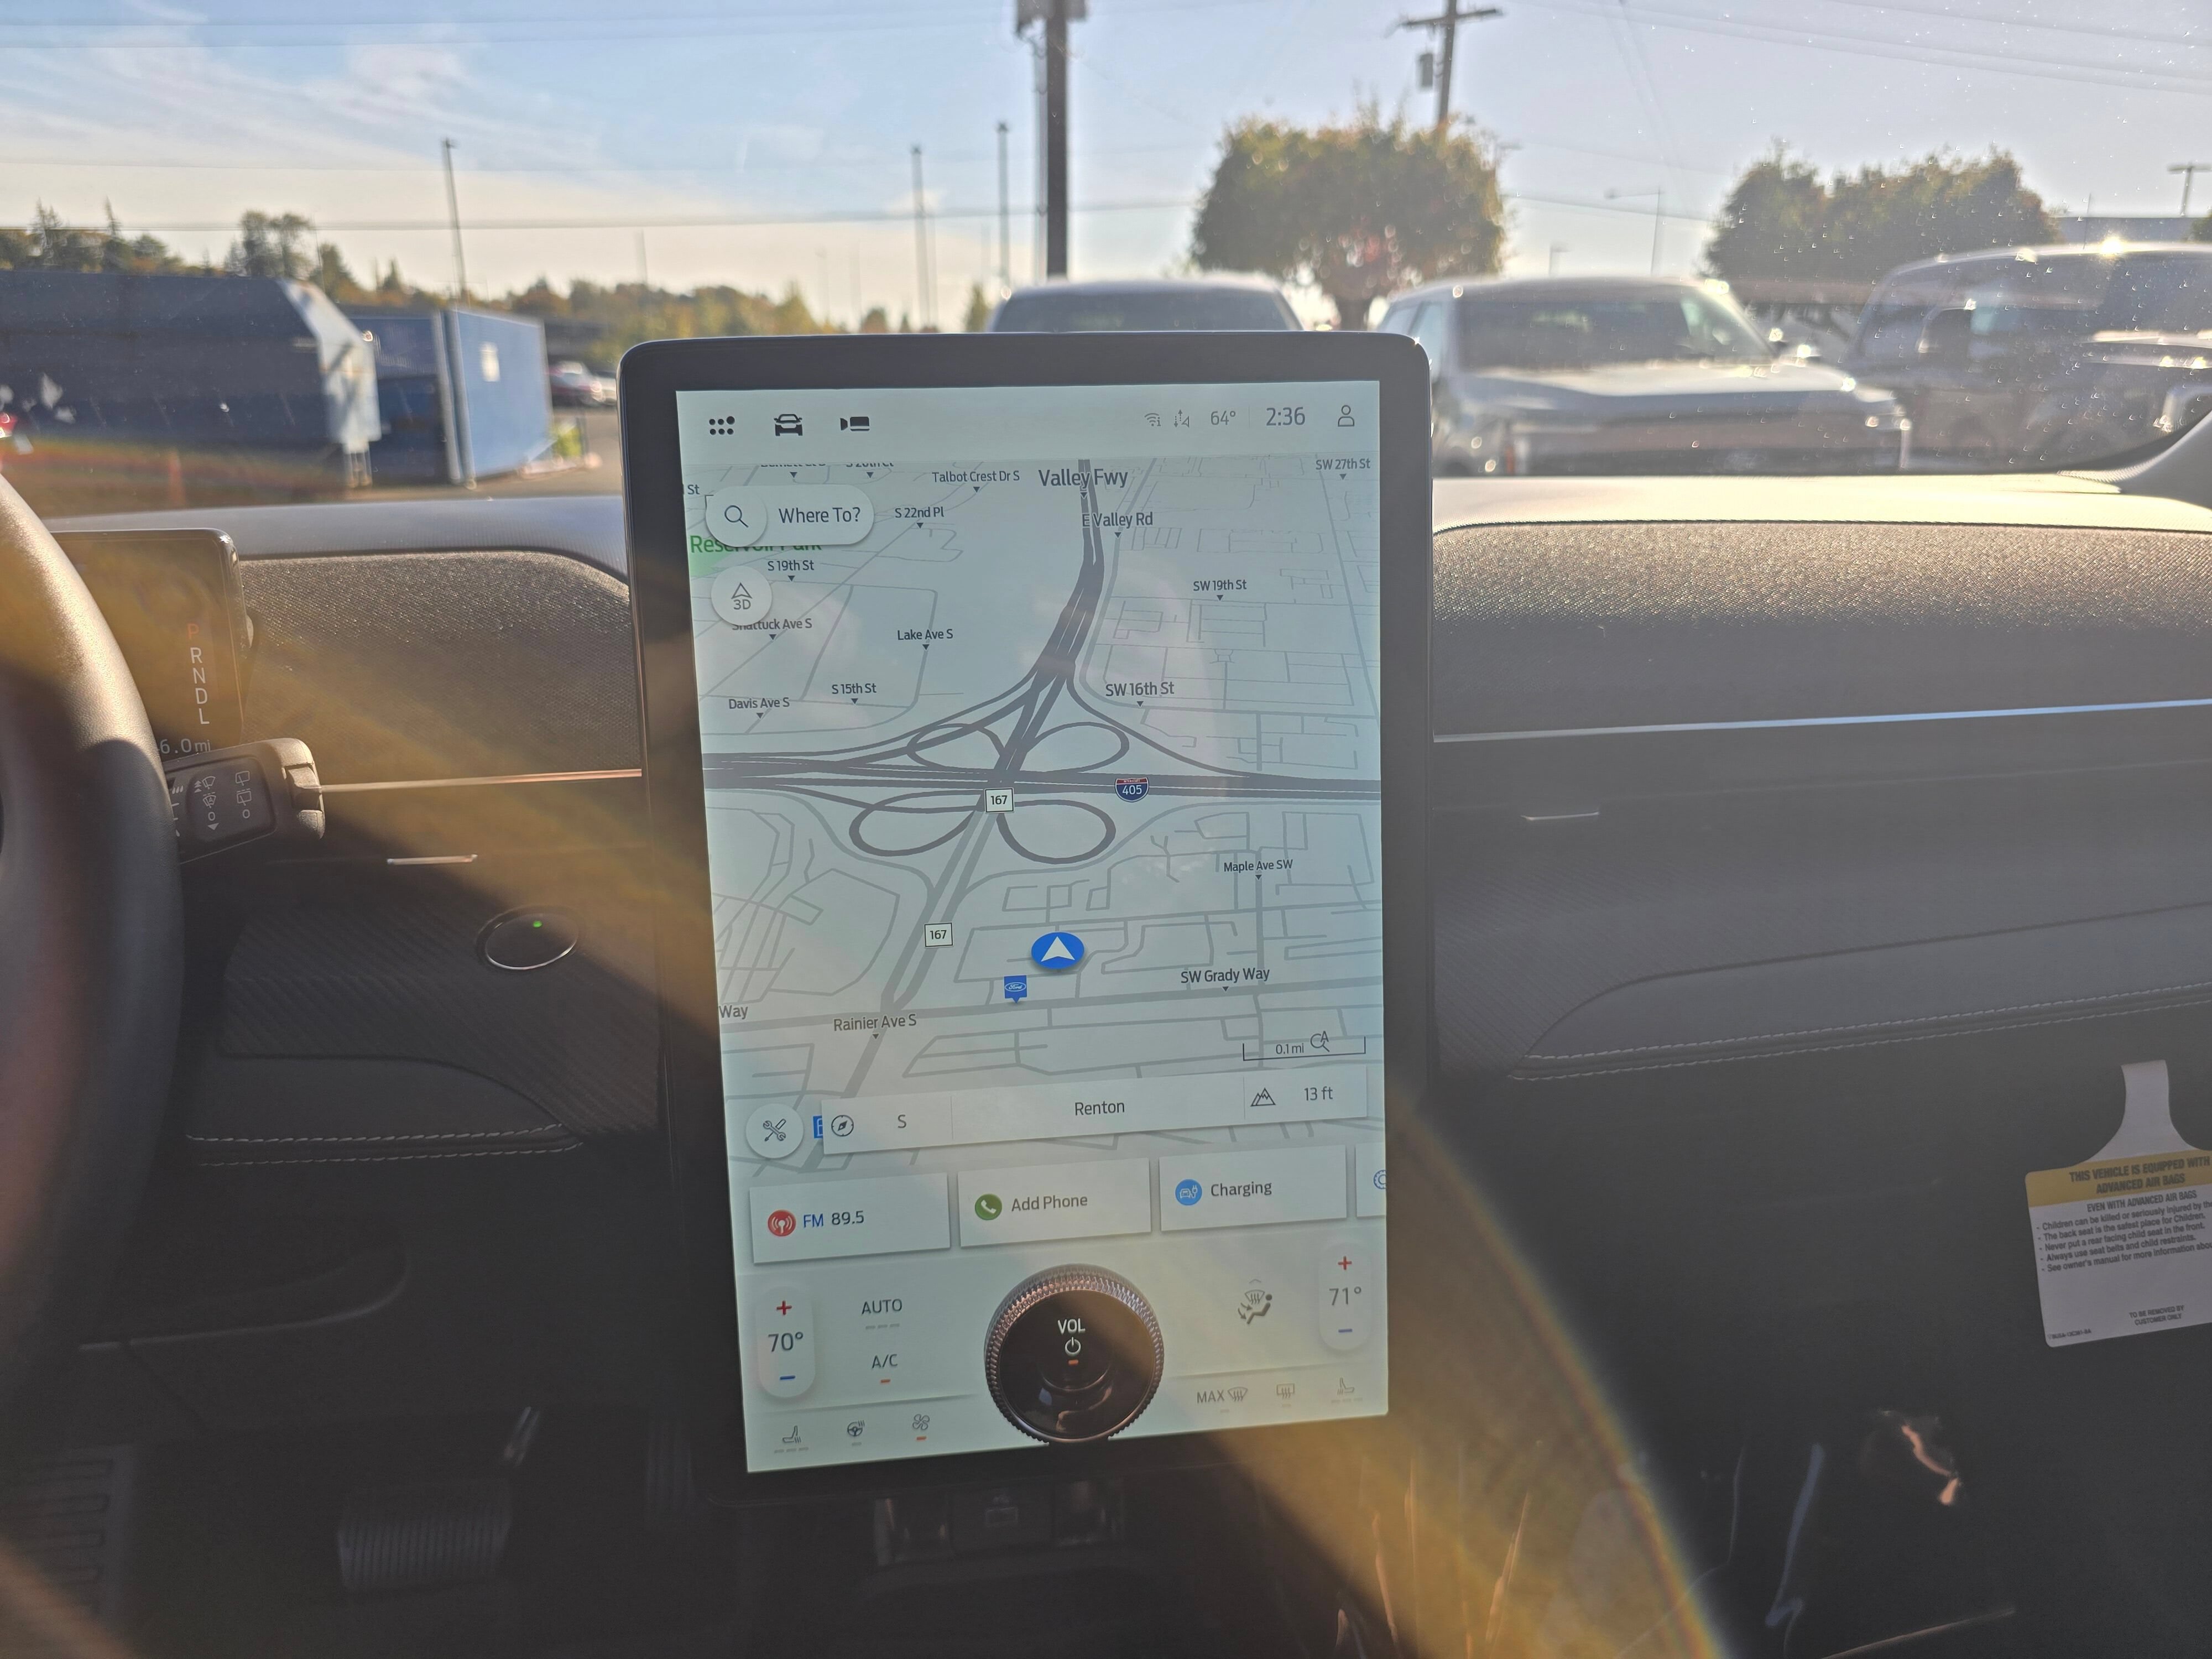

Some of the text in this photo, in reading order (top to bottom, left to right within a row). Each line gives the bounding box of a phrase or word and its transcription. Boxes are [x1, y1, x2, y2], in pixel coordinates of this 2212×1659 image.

[1211, 410, 1236, 426] 64°
[1266, 406, 1306, 426] 2:36
[1316, 458, 1370, 470] SW 27th St
[932, 471, 1020, 483] Talbot Crest Dr S
[1038, 468, 1128, 489] Valley Fwy
[687, 484, 700, 494] St
[779, 507, 861, 524] Where To?
[895, 506, 944, 519] S 22nd Pl
[1082, 512, 1153, 529] E Valley Rd
[768, 560, 814, 571] S 19th St
[1193, 580, 1247, 592] SW 19th St
[733, 599, 751, 611] 3D
[782, 619, 802, 629] Ave
[805, 618, 812, 628] S
[898, 629, 953, 641] Lake Ave S
[187, 623, 210, 724] P R N D L
[832, 683, 877, 695] S 15th St
[1106, 682, 1175, 697] SW 16th St
[729, 697, 790, 709] Davis Ave S
[1122, 785, 1142, 795] 405
[991, 795, 1008, 805] 167
[1224, 859, 1293, 874] Maple Ave SW
[930, 930, 947, 940] 167
[1181, 968, 1270, 984] SW Grady Way
[719, 1005, 748, 1020] Way
[833, 1014, 917, 1031] Rainier Ave S
[1304, 1086, 1333, 1100] 13 ft
[1074, 1101, 1125, 1115] Renton
[898, 1115, 907, 1129] S
[2069, 1156, 2210, 1182] THIS VEHICLE IS EQUIPPED WITH
[1211, 1181, 1272, 1199] Charging
[2096, 1173, 2185, 1194] ADVANCED AIR BAGS
[1011, 1195, 1088, 1212] Add Phone
[2087, 1190, 2197, 1213] EVEN WITH ADVANCED AIR BAGS
[804, 1211, 865, 1228] FM 89.5
[2042, 1220, 2073, 1230] Children
[2100, 1212, 2120, 1222] killed
[2131, 1207, 2164, 1218] seriously
[2167, 1203, 2192, 1214] injured
[2193, 1202, 2201, 1211] by
[2044, 1233, 2058, 1241] The
[2059, 1230, 2077, 1239] back
[2078, 1227, 2094, 1236] seat
[2104, 1224, 2115, 1232] the
[2117, 1220, 2138, 1230] safest
[2140, 1219, 2160, 1229] place
[2162, 1216, 2172, 1224] for
[2045, 1241, 2066, 1251] Never
[2068, 1240, 2080, 1250] put
[2104, 1233, 2126, 1243] facing
[2128, 1230, 2146, 1239] child
[2147, 1228, 2163, 1237] seat
[2047, 1252, 2073, 1261] Always
[2089, 1246, 2105, 1255] seat
[2106, 1244, 2124, 1254] belts
[2126, 1241, 2139, 1250] and
[2141, 1238, 2158, 1248] child
[2047, 1264, 2061, 1272] See
[2063, 1259, 2092, 1270] owner's
[2093, 1254, 2120, 1265] manual
[2121, 1253, 2132, 1261] for
[2133, 1251, 2152, 1260] more
[2153, 1245, 2195, 1256] information
[1329, 1286, 1362, 1306] 71°
[862, 1299, 902, 1315] AUTO
[2148, 1306, 2176, 1316] REMOVED
[1058, 1318, 1086, 1334] VOL
[2135, 1316, 2166, 1326] CUSTOMER
[768, 1332, 804, 1353] 70°
[872, 1354, 898, 1369] A/C
[1197, 1389, 1225, 1404] MAX
